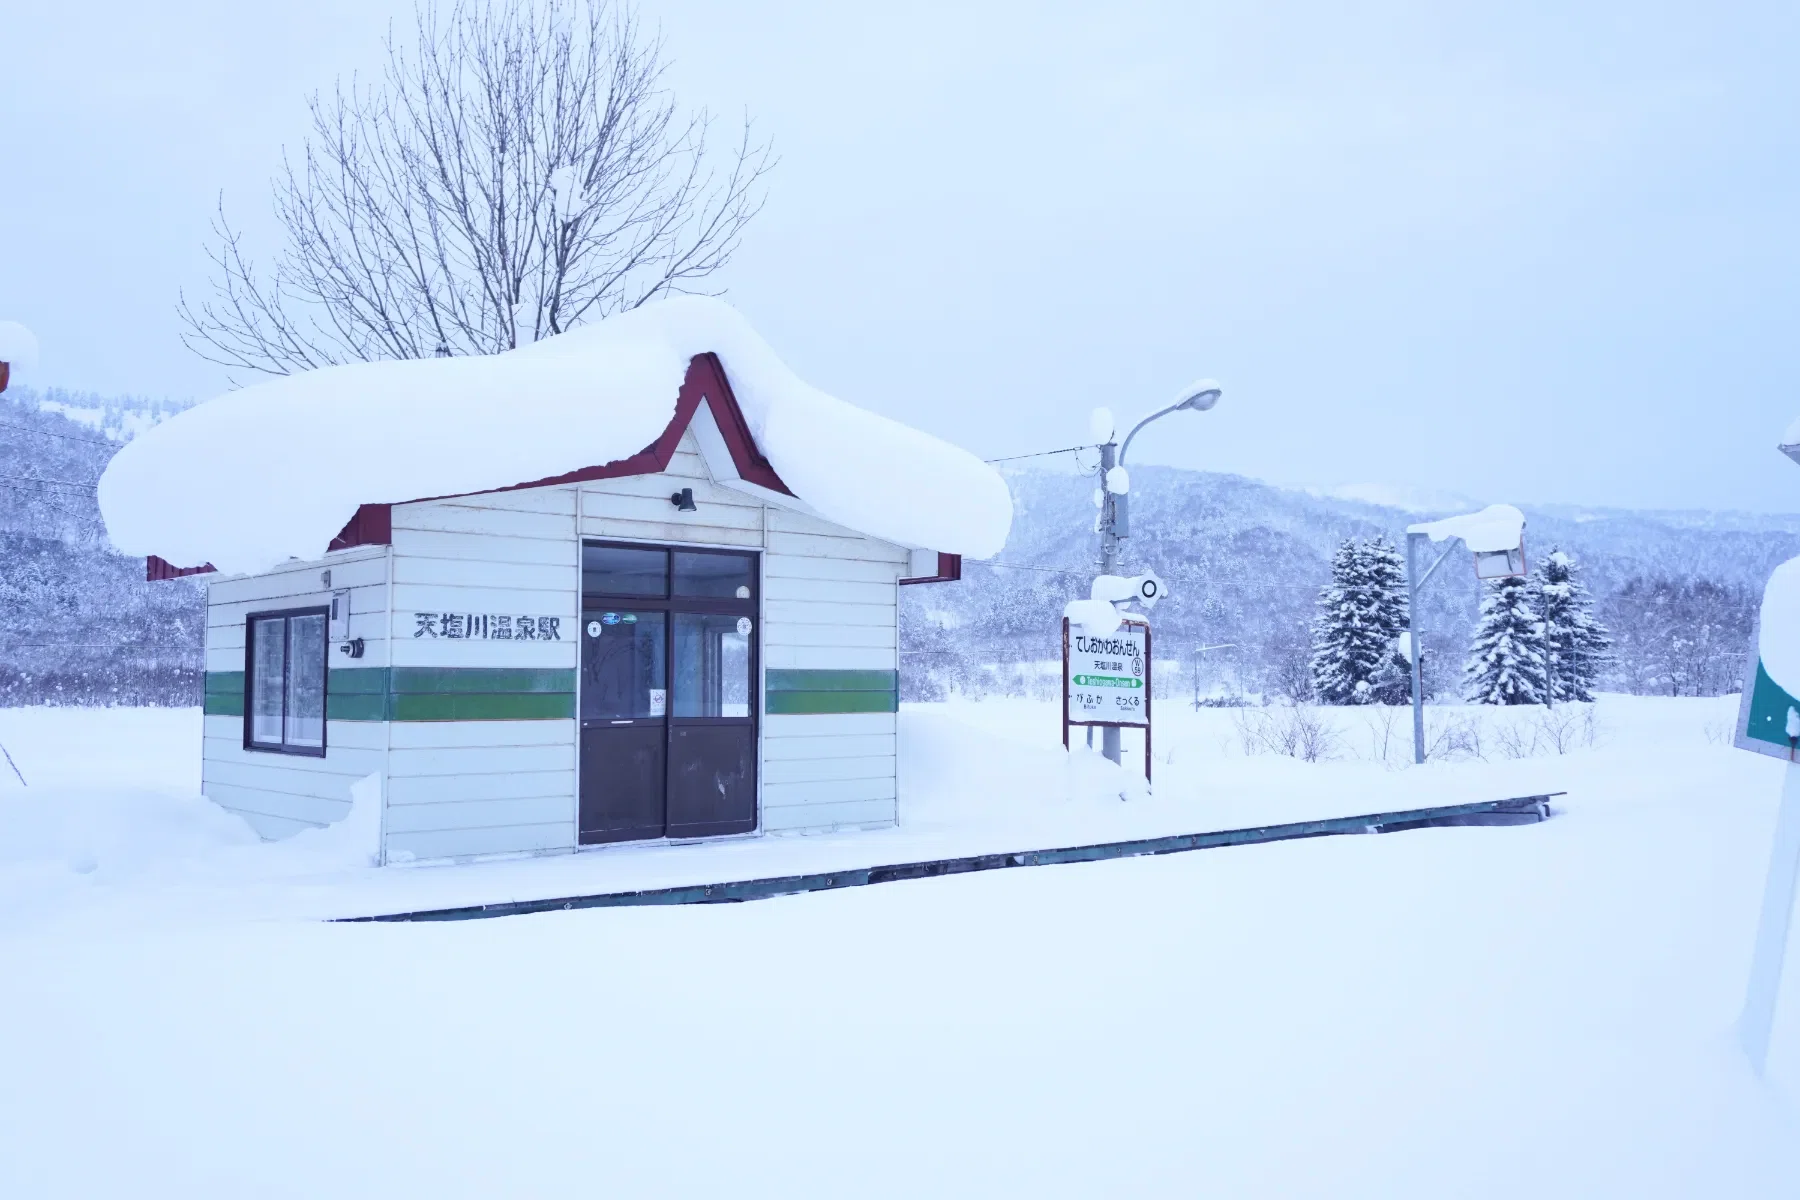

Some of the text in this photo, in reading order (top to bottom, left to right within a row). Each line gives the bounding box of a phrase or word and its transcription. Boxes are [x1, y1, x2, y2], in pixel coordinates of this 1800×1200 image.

[413, 612, 561, 641] 天塩川温泉駅
[1094, 660, 1123, 672] 天塩川温泉
[1115, 696, 1140, 706] さっくる
